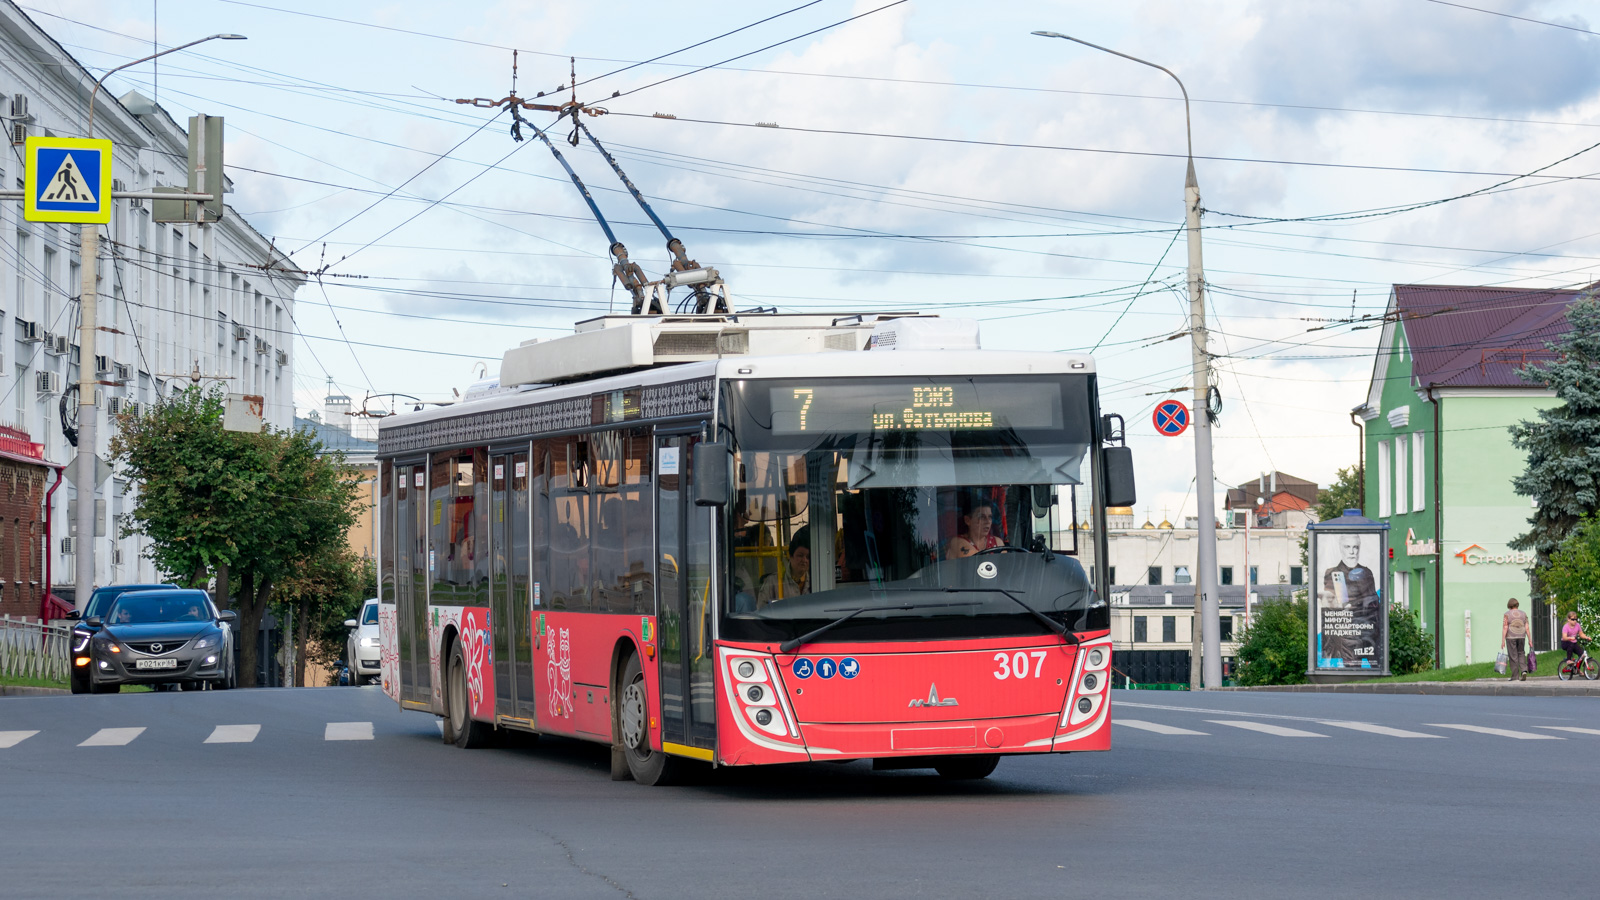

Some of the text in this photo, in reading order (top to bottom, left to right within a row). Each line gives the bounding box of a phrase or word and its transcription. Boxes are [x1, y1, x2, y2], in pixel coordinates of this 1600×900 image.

[793, 388, 814, 431] 7
[1354, 646, 1374, 655] TELE2
[993, 651, 1047, 680] 307
